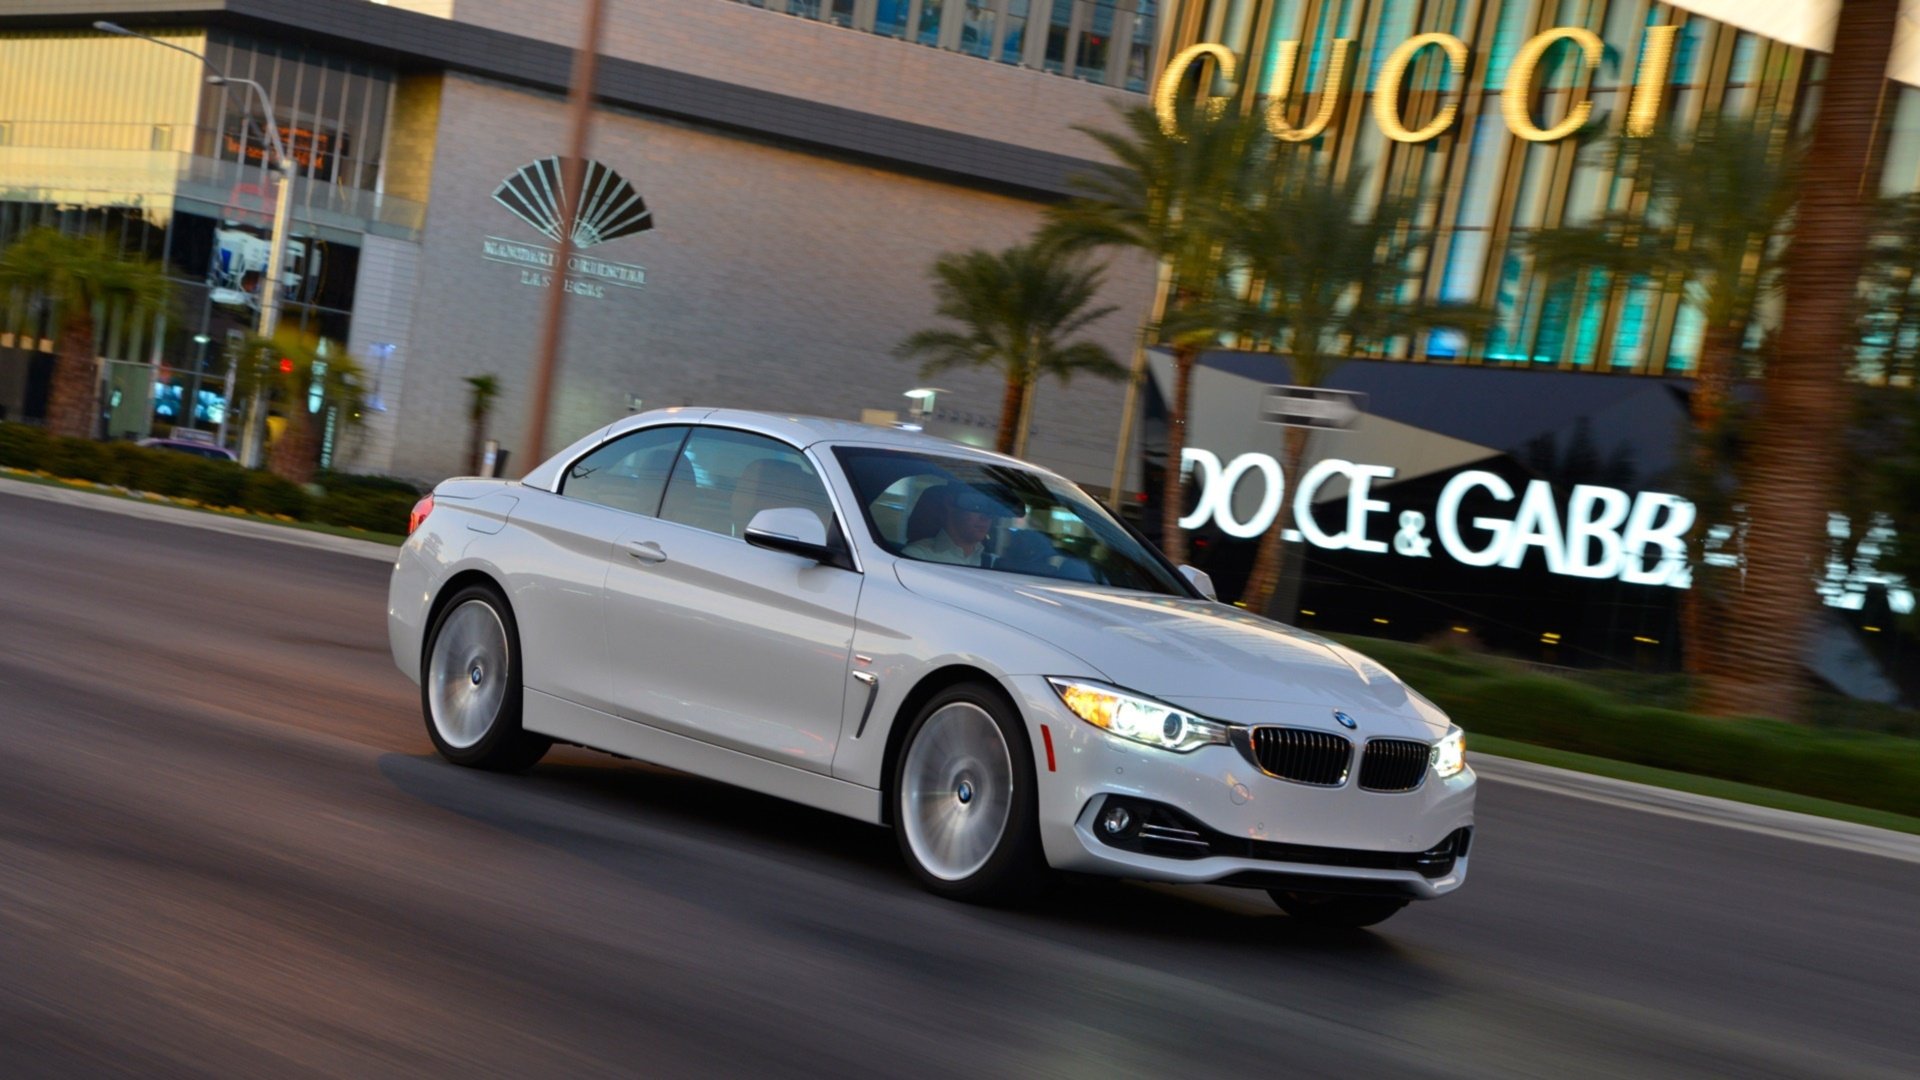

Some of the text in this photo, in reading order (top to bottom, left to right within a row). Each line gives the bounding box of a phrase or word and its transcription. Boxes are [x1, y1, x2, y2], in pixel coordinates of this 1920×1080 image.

[1154, 24, 1680, 143] GUCCI
[482, 240, 646, 284] MANDARI ORIENTAL
[519, 270, 607, 298] LAS EGAS
